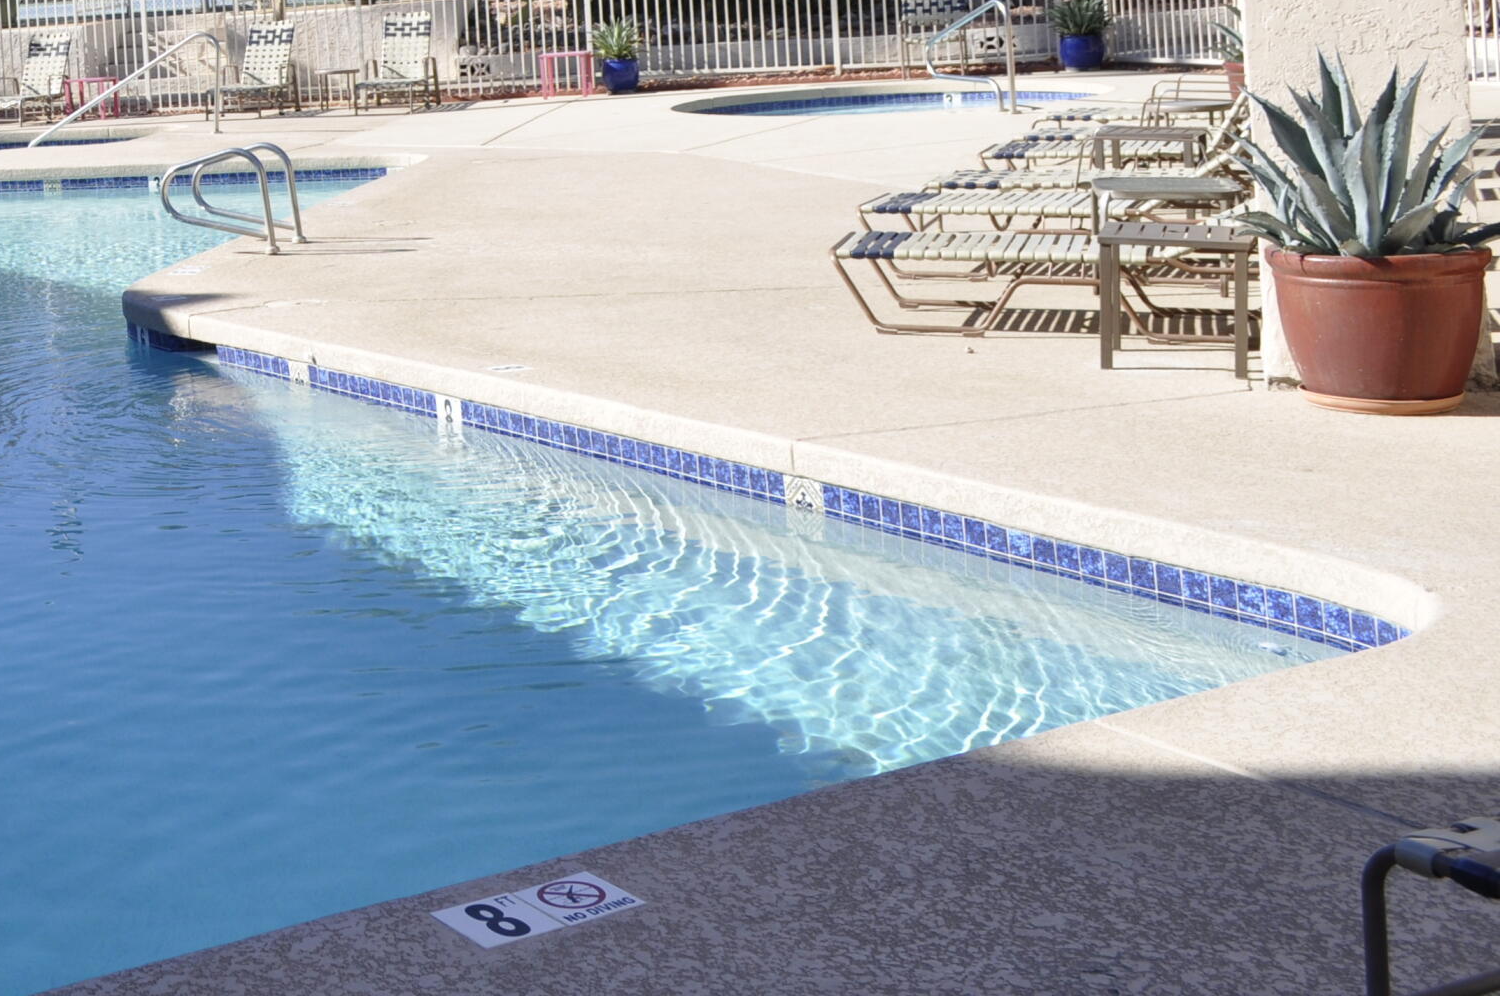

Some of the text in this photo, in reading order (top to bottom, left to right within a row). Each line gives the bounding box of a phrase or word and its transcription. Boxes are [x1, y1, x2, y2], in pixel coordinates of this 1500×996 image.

[465, 896, 531, 937] 8 FT
[563, 896, 636, 922] NO DIVING
